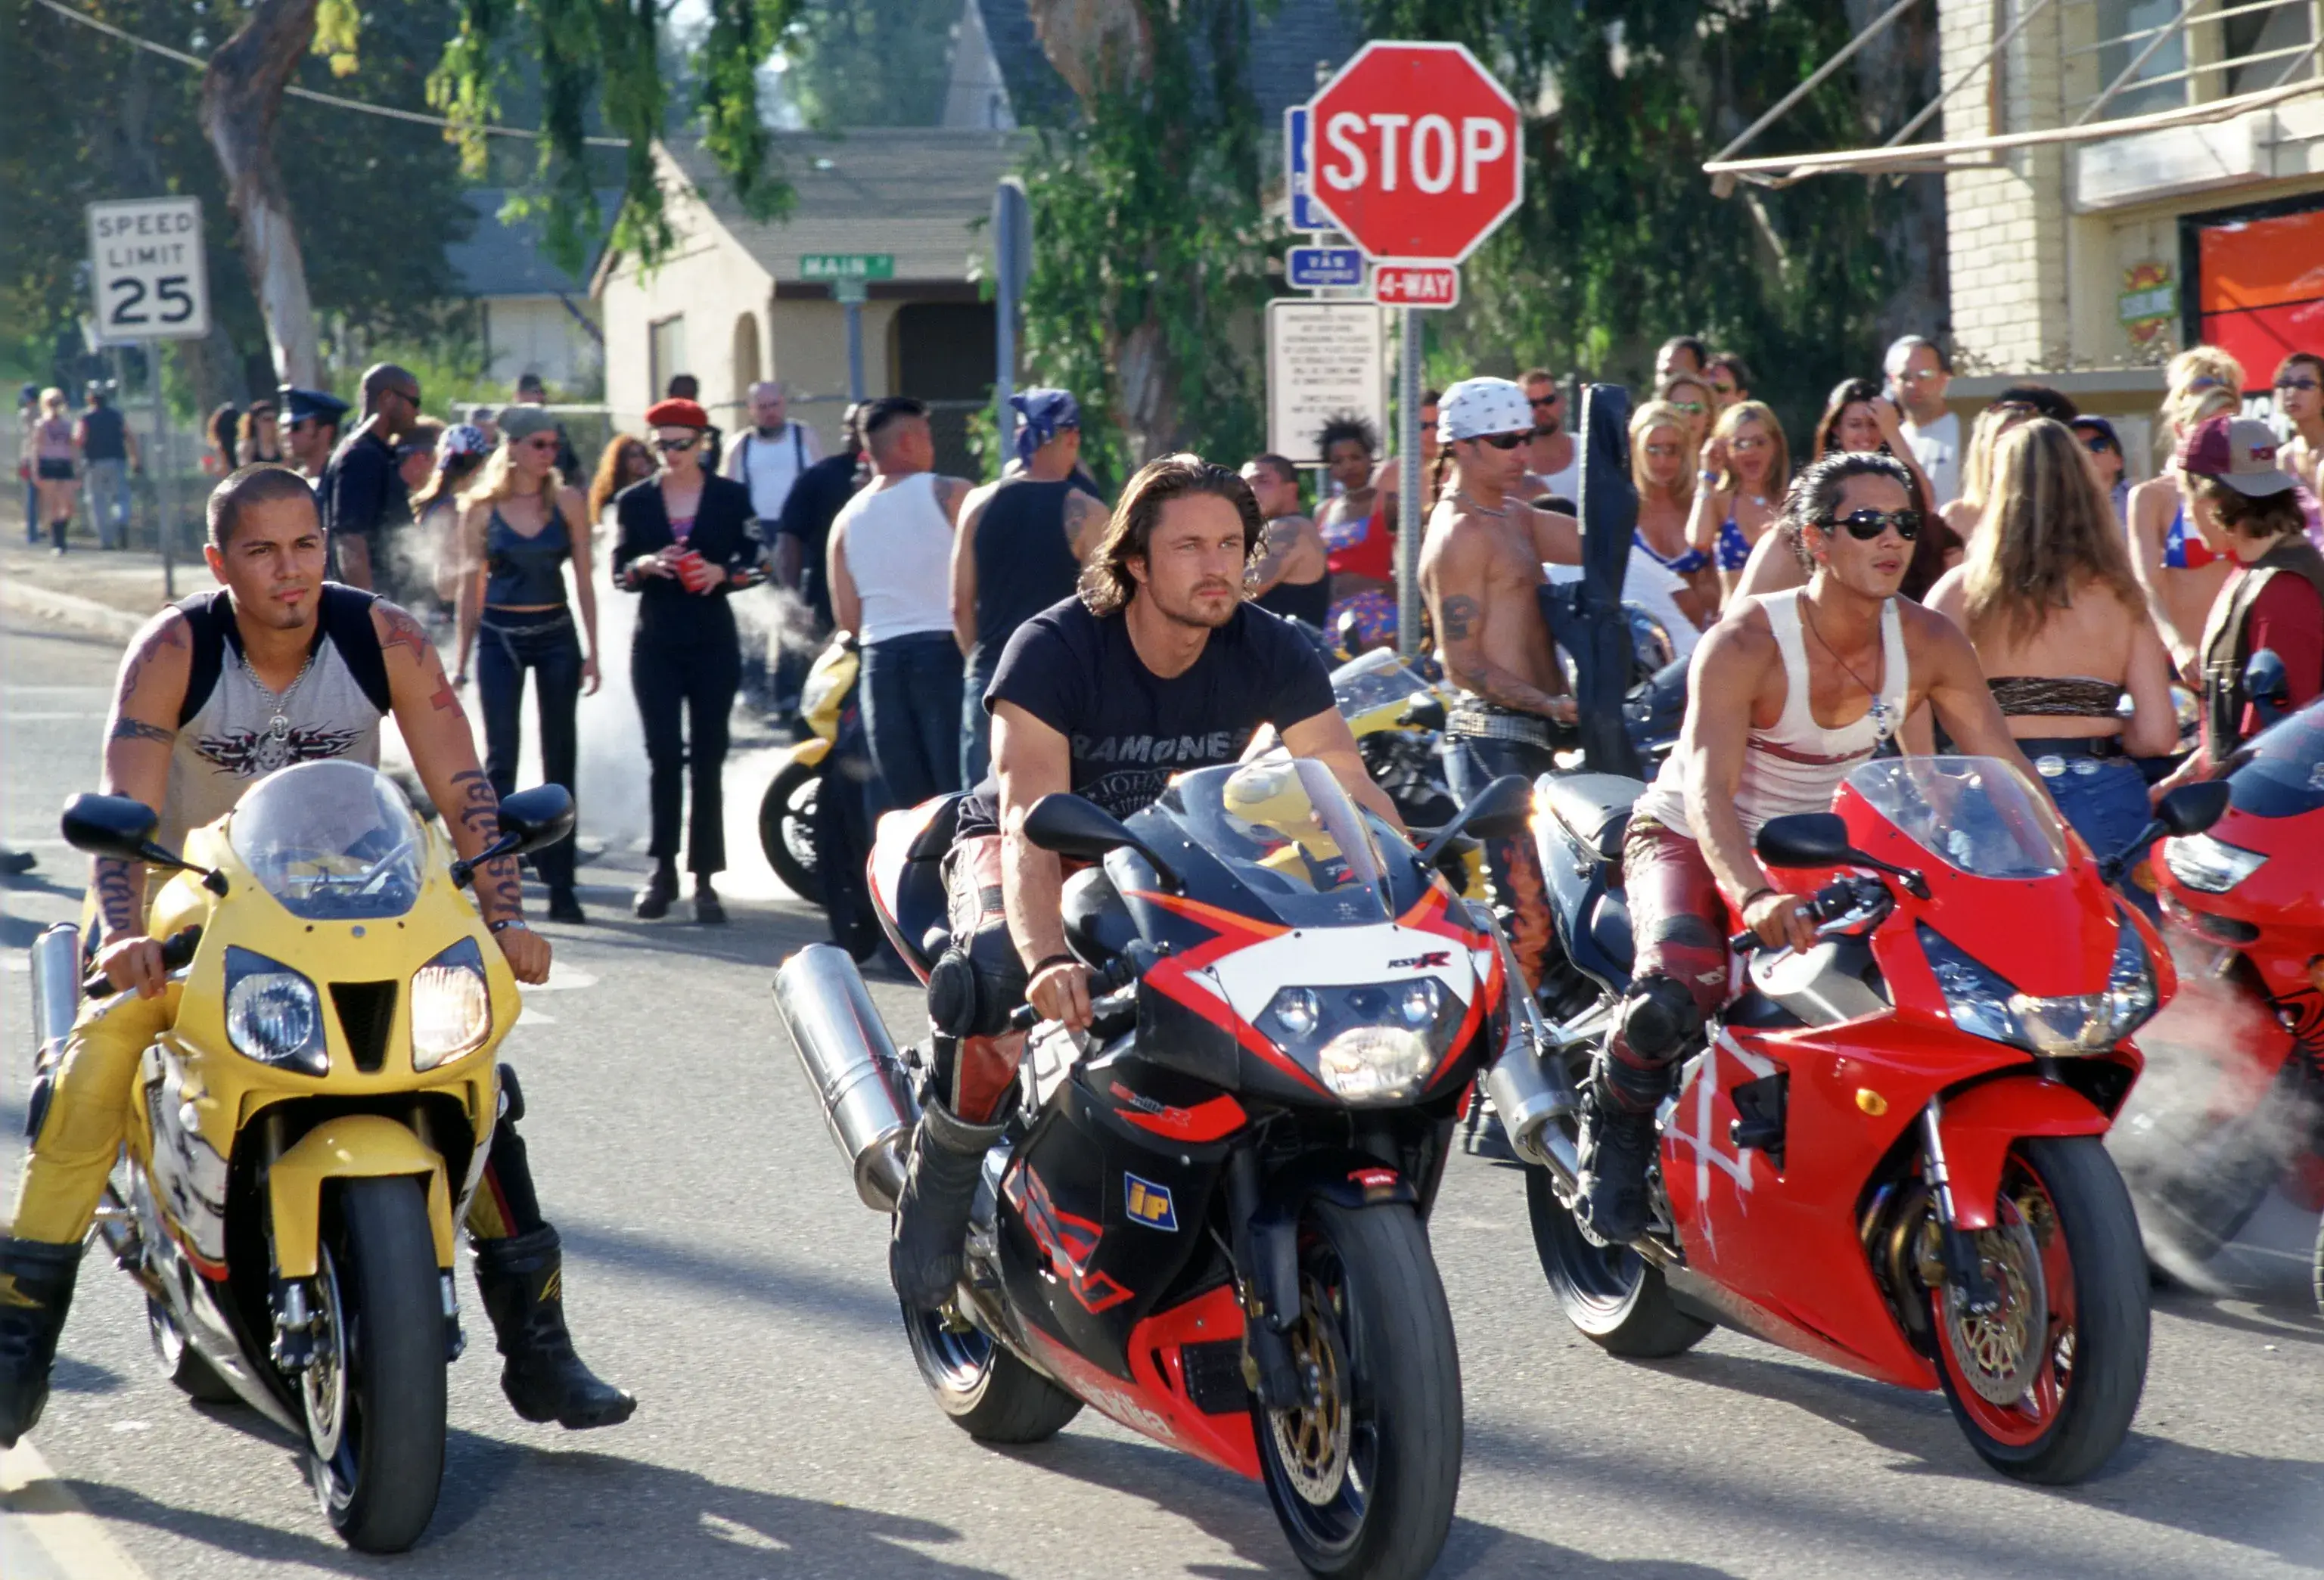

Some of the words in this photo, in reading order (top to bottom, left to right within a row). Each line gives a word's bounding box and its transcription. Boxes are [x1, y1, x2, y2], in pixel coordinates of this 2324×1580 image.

[1322, 111, 1507, 194] STOP
[97, 213, 192, 237] SPEED
[107, 243, 185, 268] LIMIT
[1379, 272, 1451, 297] 4-WAY
[109, 275, 193, 325] 25
